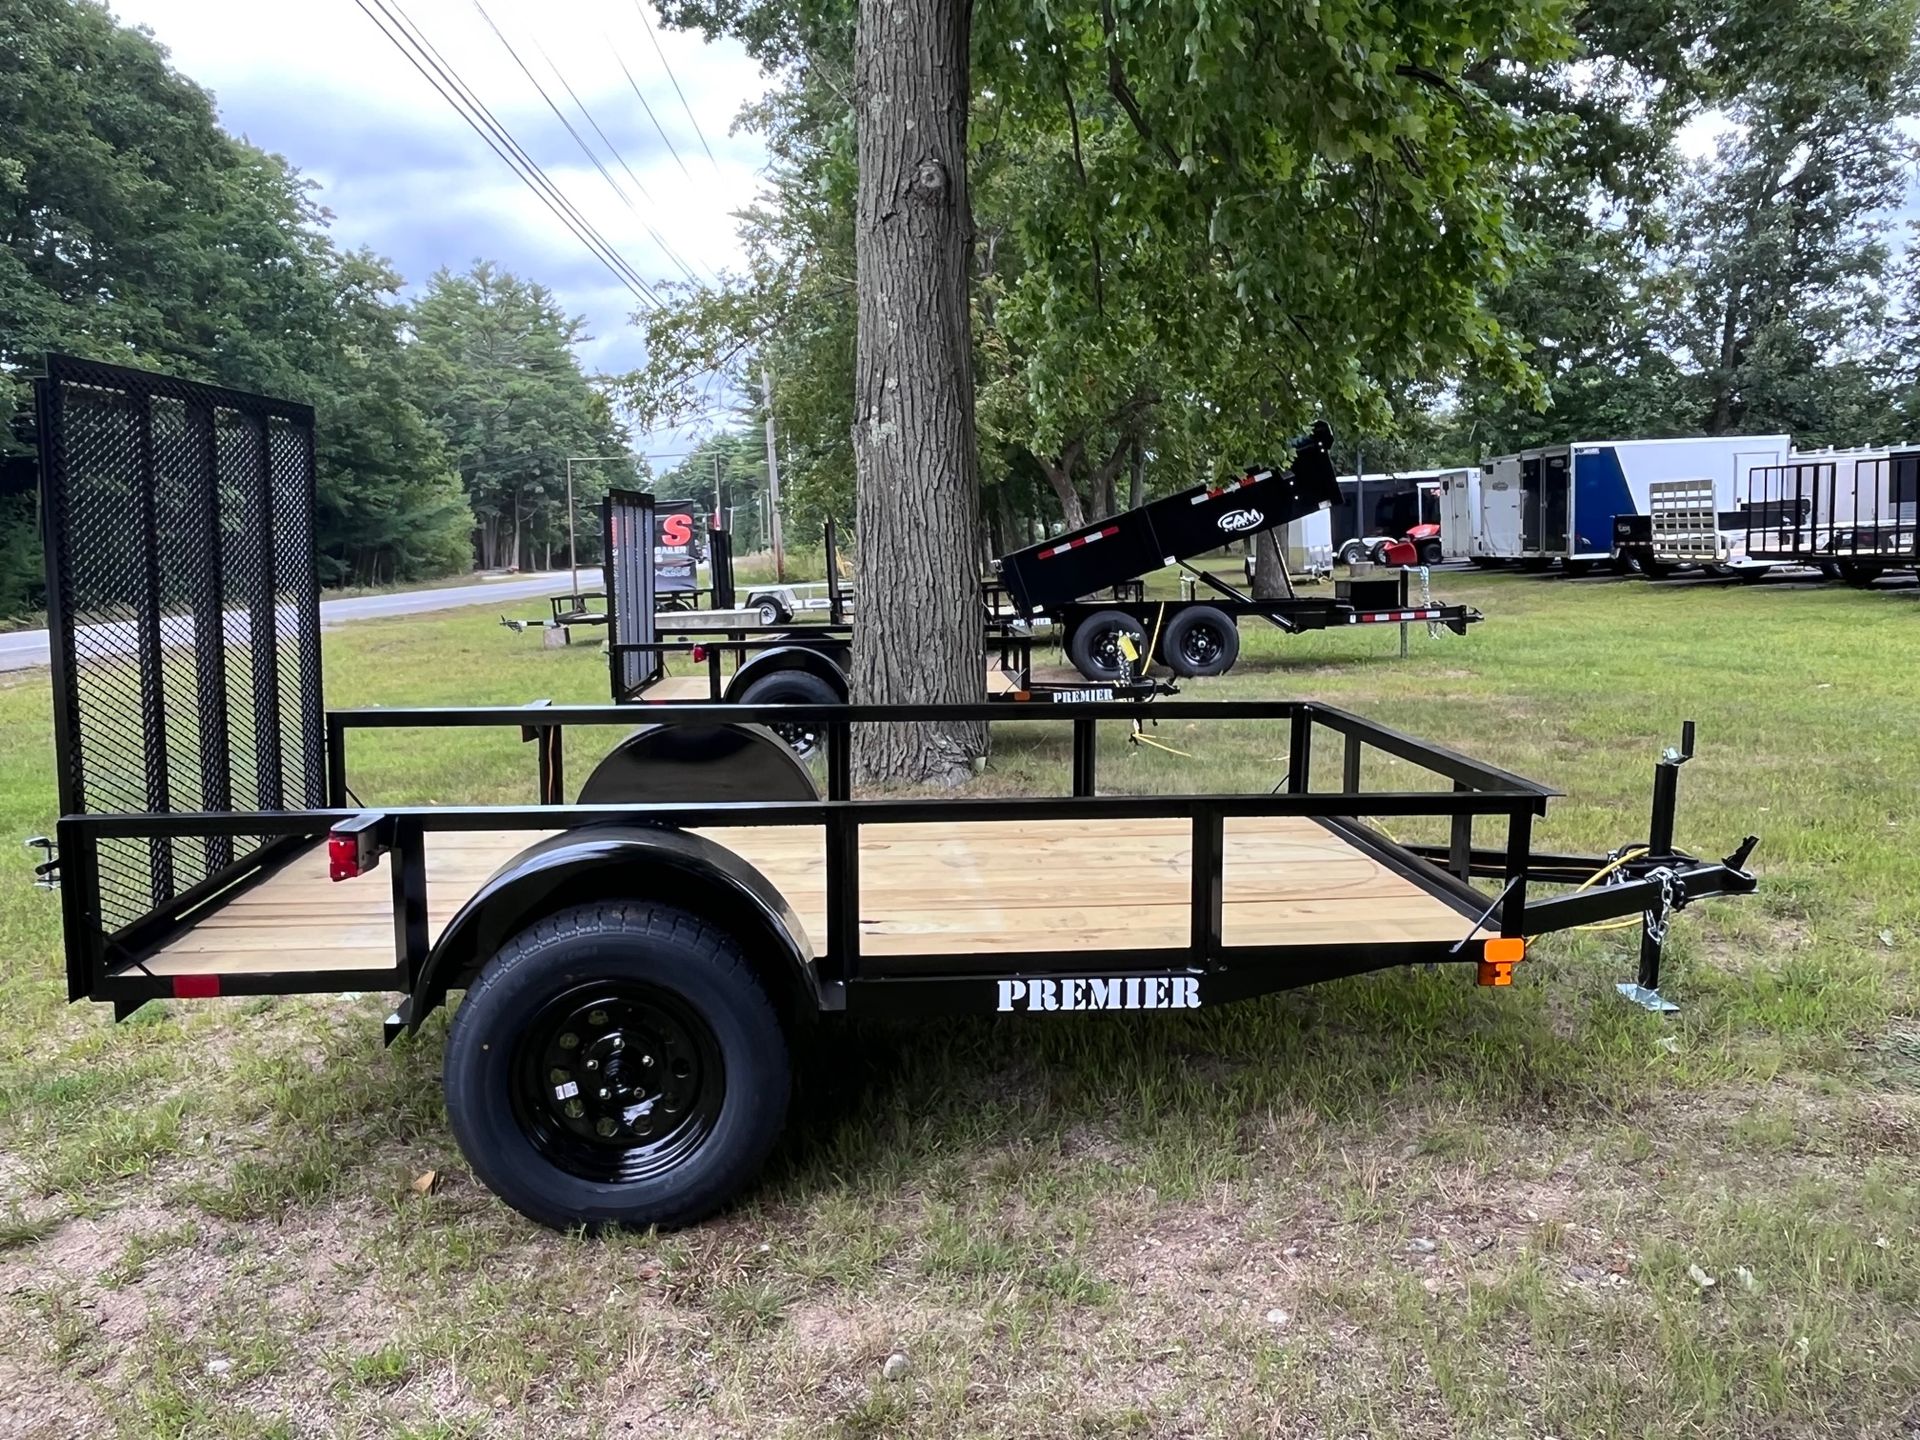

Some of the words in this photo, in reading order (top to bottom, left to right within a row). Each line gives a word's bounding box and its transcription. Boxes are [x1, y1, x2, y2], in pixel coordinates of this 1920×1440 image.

[1222, 508, 1260, 529] CAM
[1053, 688, 1114, 704] PREMIER
[997, 977, 1202, 1011] PREMIER
